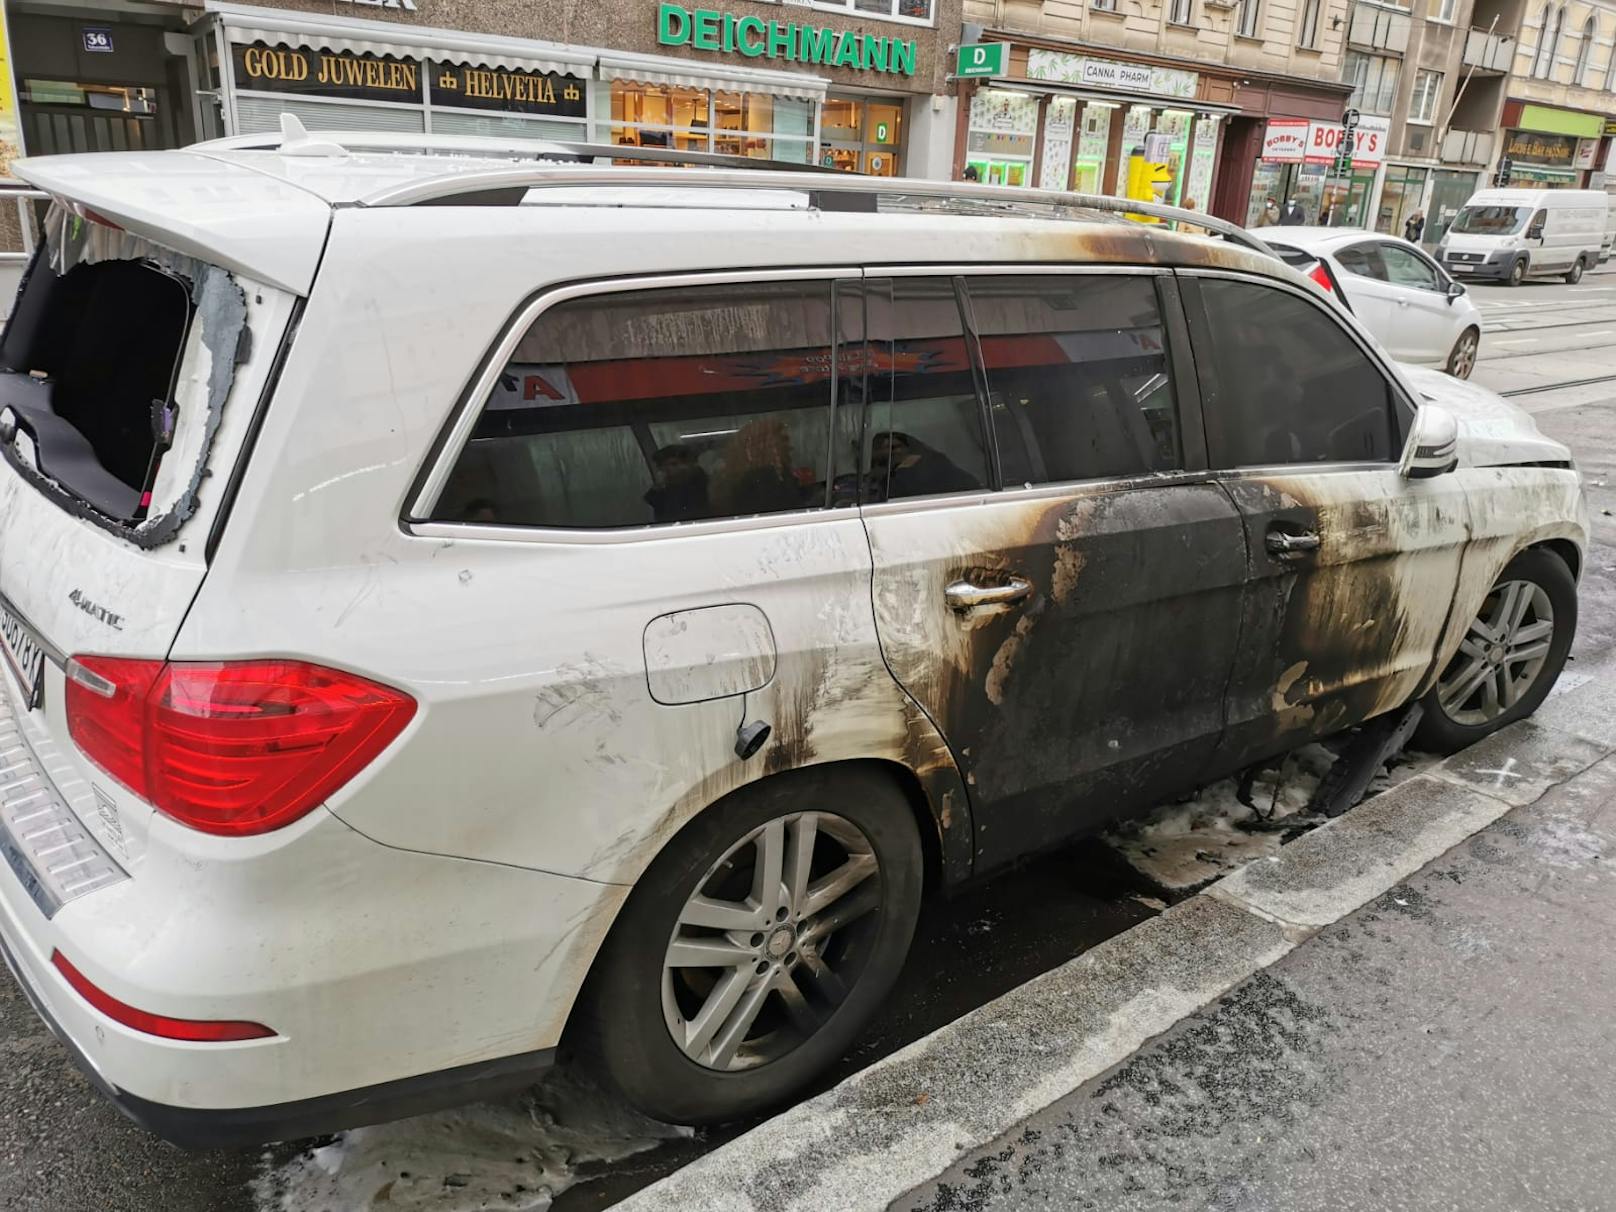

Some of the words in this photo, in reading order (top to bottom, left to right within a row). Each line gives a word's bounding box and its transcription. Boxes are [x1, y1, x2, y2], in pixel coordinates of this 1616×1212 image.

[86, 33, 107, 45] 36
[657, 2, 917, 76] DEICHMANN
[244, 47, 308, 81] GOLD
[317, 55, 417, 91] JUWELEN
[973, 47, 986, 65] D
[464, 69, 557, 104] HELVETIA
[1086, 65, 1115, 79] CANNA
[1120, 70, 1149, 83] PHARM
[878, 125, 887, 140] D
[68, 587, 126, 631] 4MATIC
